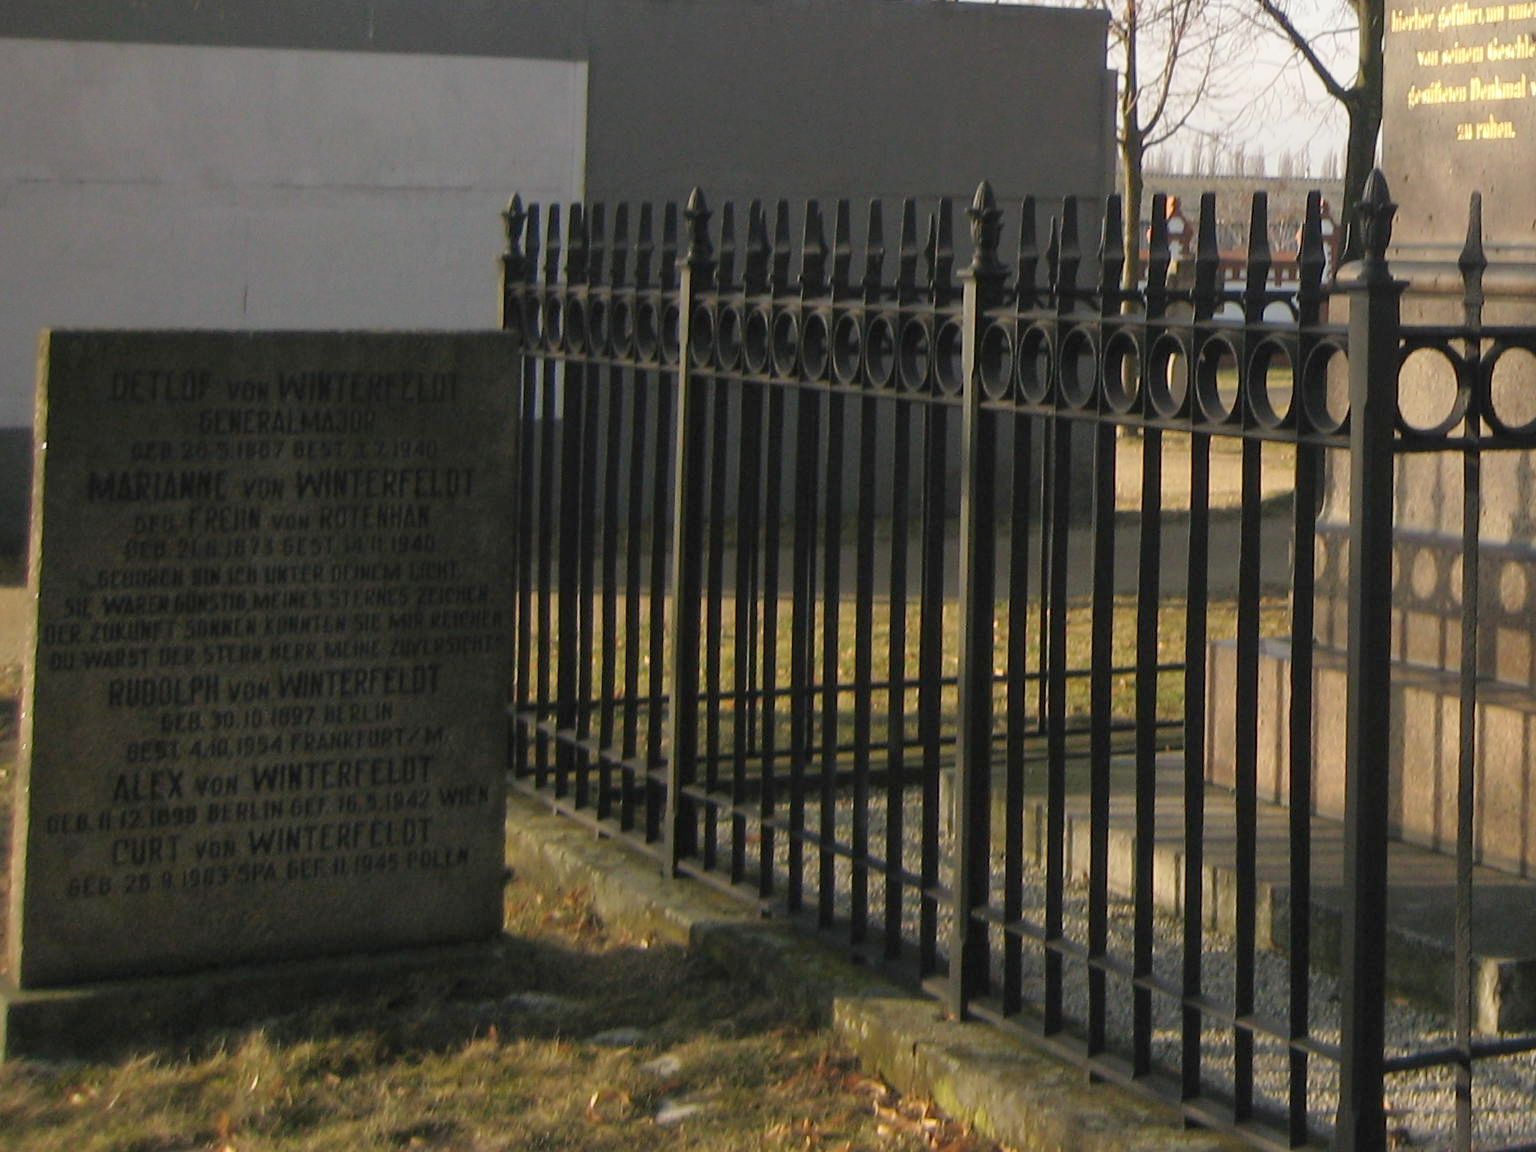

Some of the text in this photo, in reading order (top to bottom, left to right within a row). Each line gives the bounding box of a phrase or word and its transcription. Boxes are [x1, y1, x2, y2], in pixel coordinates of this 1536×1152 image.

[1391, 6, 1434, 32] hierher
[1417, 48, 1439, 66] von
[1442, 40, 1484, 65] seinem
[1470, 73, 1526, 100] Denkmal
[1457, 123, 1472, 140] zu
[109, 369, 213, 404] DETLOF
[279, 370, 457, 405] WINTERFELDT
[200, 409, 376, 436] GENERALMAJOR
[86, 469, 226, 503] MARIANNE
[296, 468, 474, 500] WINTERFELDT
[320, 505, 430, 530] ROTENHAN
[107, 674, 220, 708] RUDOLPH
[279, 665, 442, 698] WINTERFELDT
[324, 702, 394, 726] BERLIN
[112, 769, 184, 803] ALEX
[250, 753, 434, 793] WINTERFELDT
[207, 798, 284, 824] BERLIN
[438, 784, 489, 808] WIEN
[110, 833, 180, 867] CURT
[247, 816, 433, 856] WINTERFELDT
[406, 846, 469, 871] POLEN
